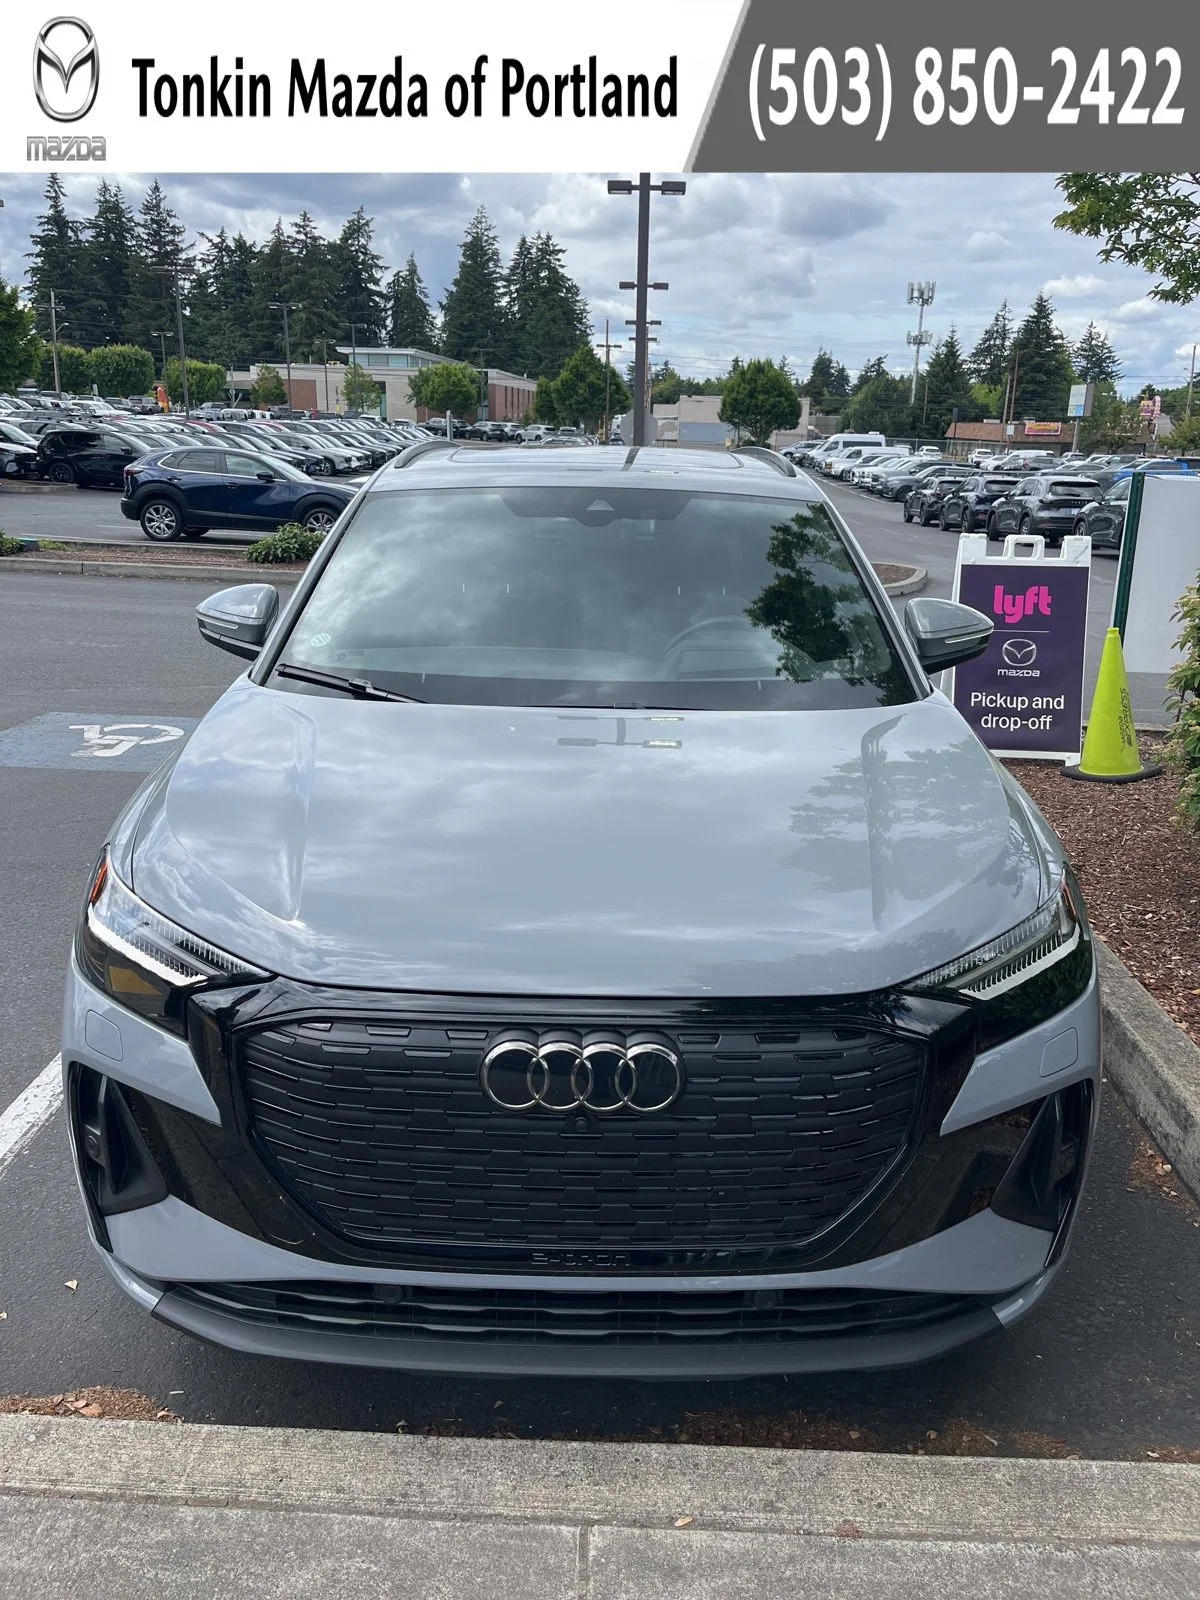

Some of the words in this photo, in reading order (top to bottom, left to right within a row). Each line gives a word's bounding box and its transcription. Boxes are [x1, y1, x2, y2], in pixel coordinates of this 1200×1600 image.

[993, 585, 1052, 624] lyft
[997, 668, 1041, 677] mazda
[970, 691, 1029, 711] Pickup
[1031, 694, 1065, 710] and
[980, 713, 1053, 732] drop-off
